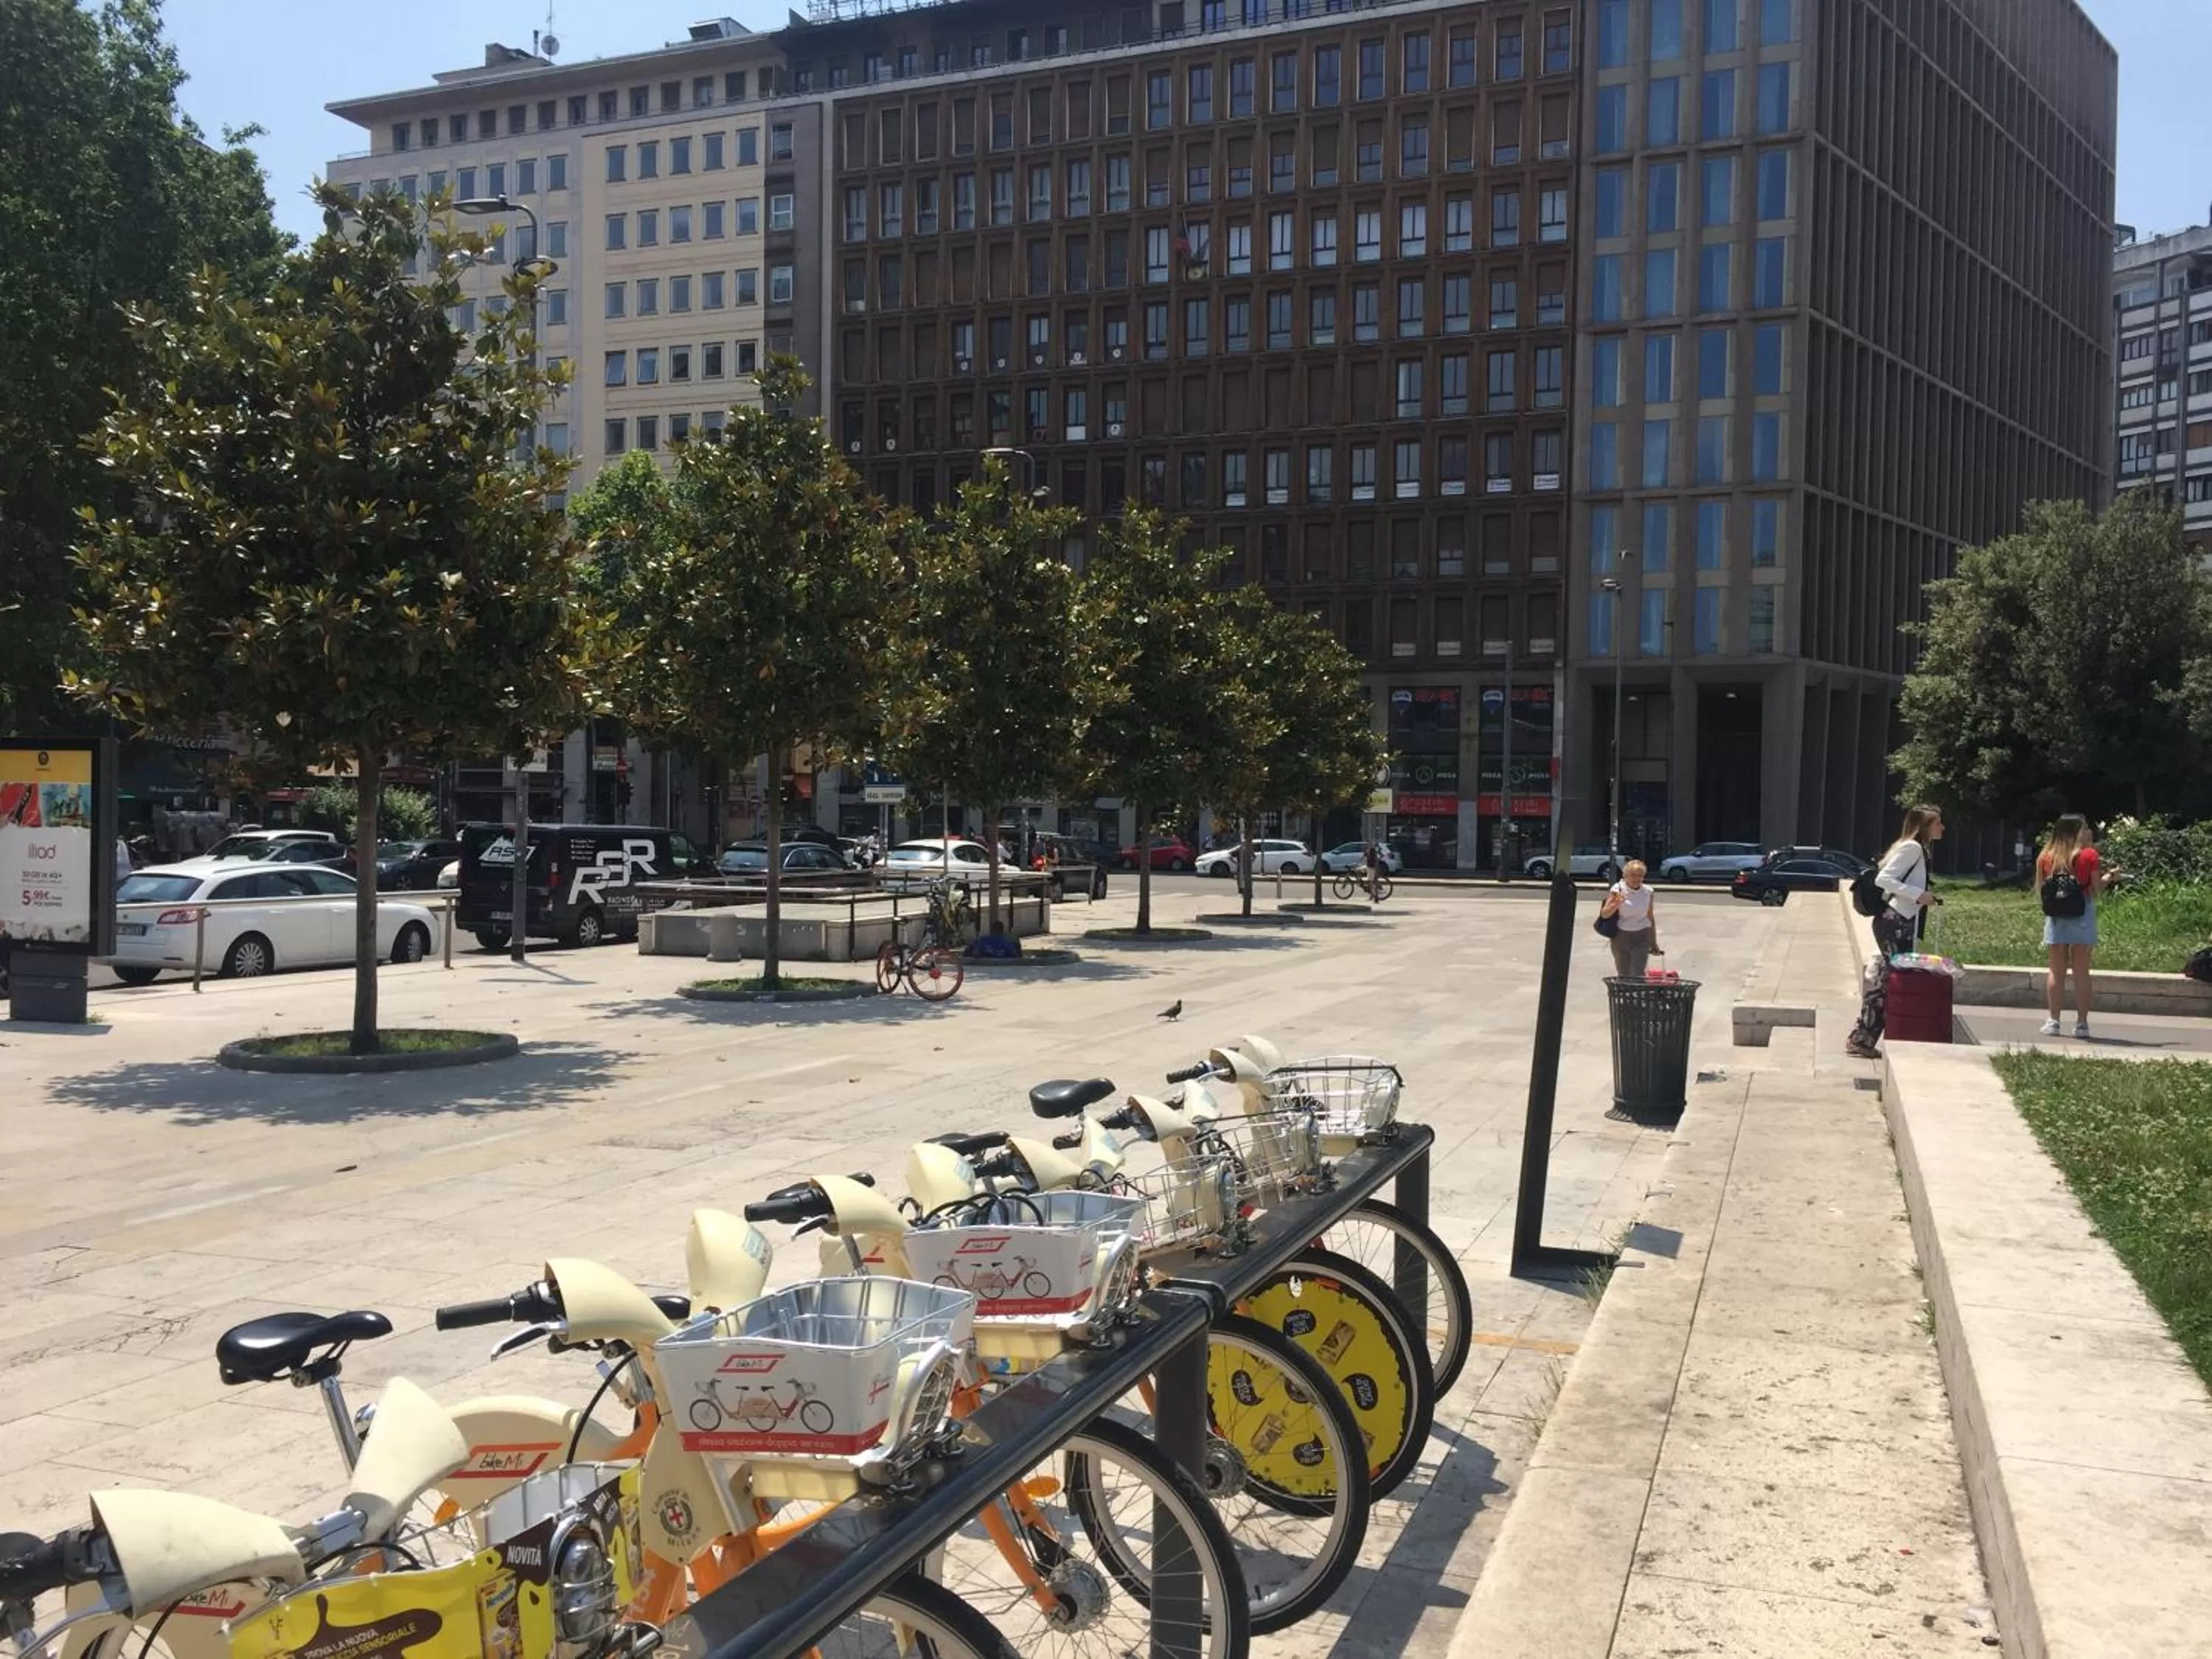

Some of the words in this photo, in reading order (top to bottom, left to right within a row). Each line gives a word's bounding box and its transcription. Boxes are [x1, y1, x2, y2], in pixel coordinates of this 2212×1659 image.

[28, 844, 56, 859] iliad
[479, 1450, 524, 1470] bikeMi
[507, 1545, 542, 1566] NOVITÀ
[344, 1628, 378, 1646] NUOVA
